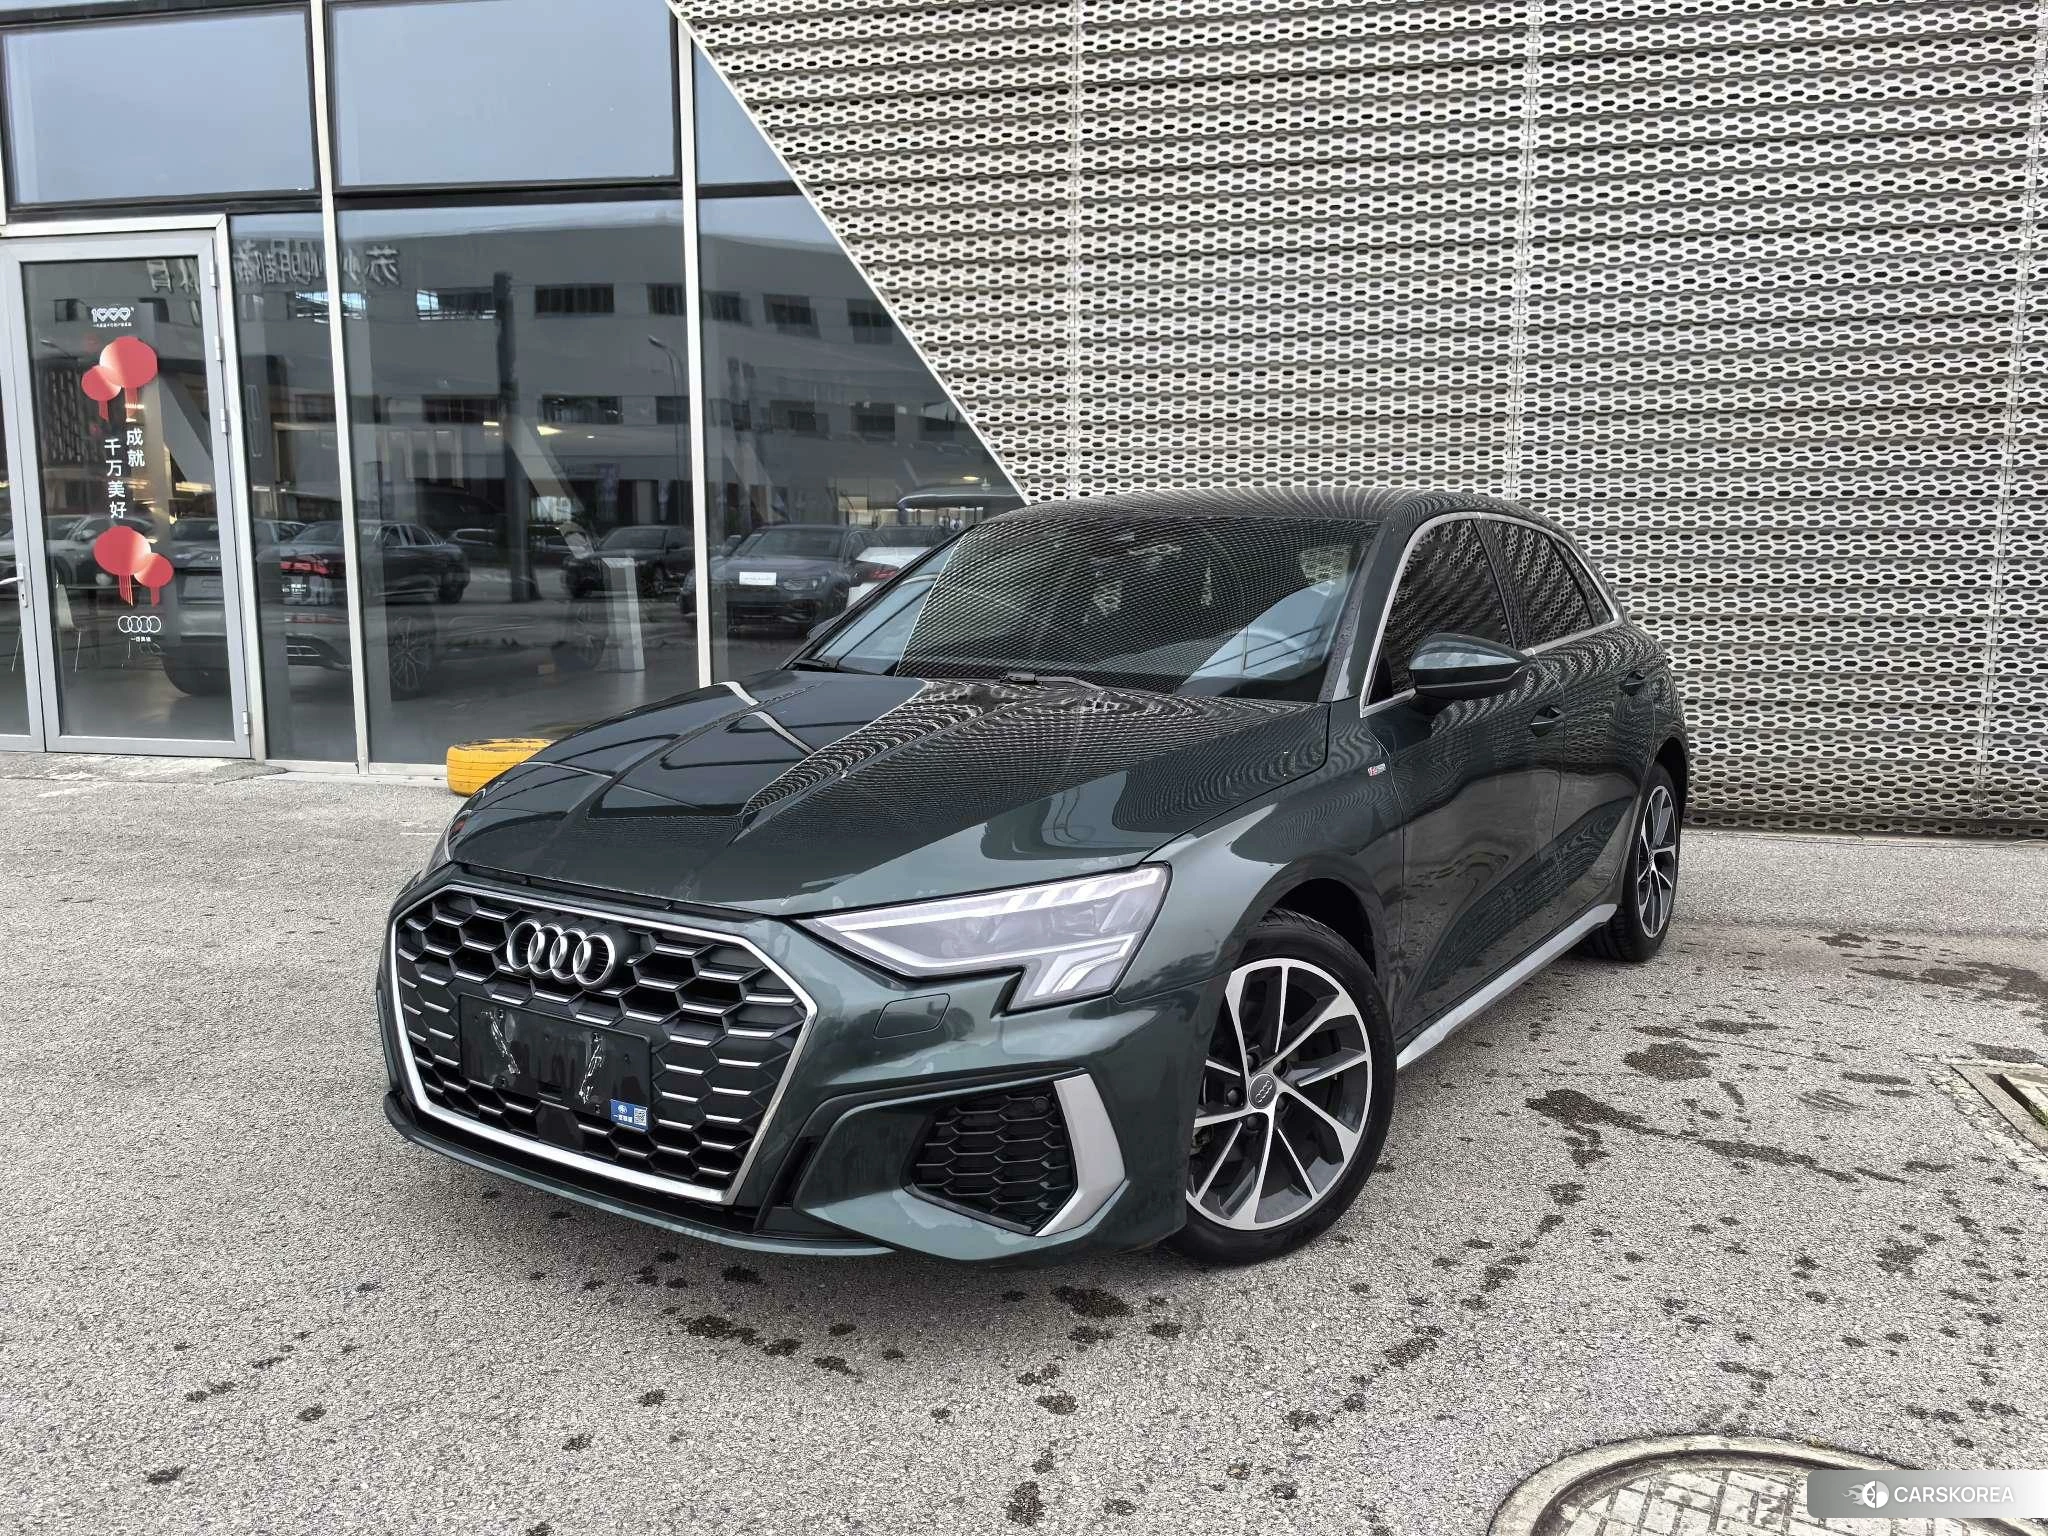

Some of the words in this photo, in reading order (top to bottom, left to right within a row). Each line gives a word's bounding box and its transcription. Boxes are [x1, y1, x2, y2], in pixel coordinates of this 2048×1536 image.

[126, 428, 145, 467] 成就
[104, 438, 127, 518] 千万美好
